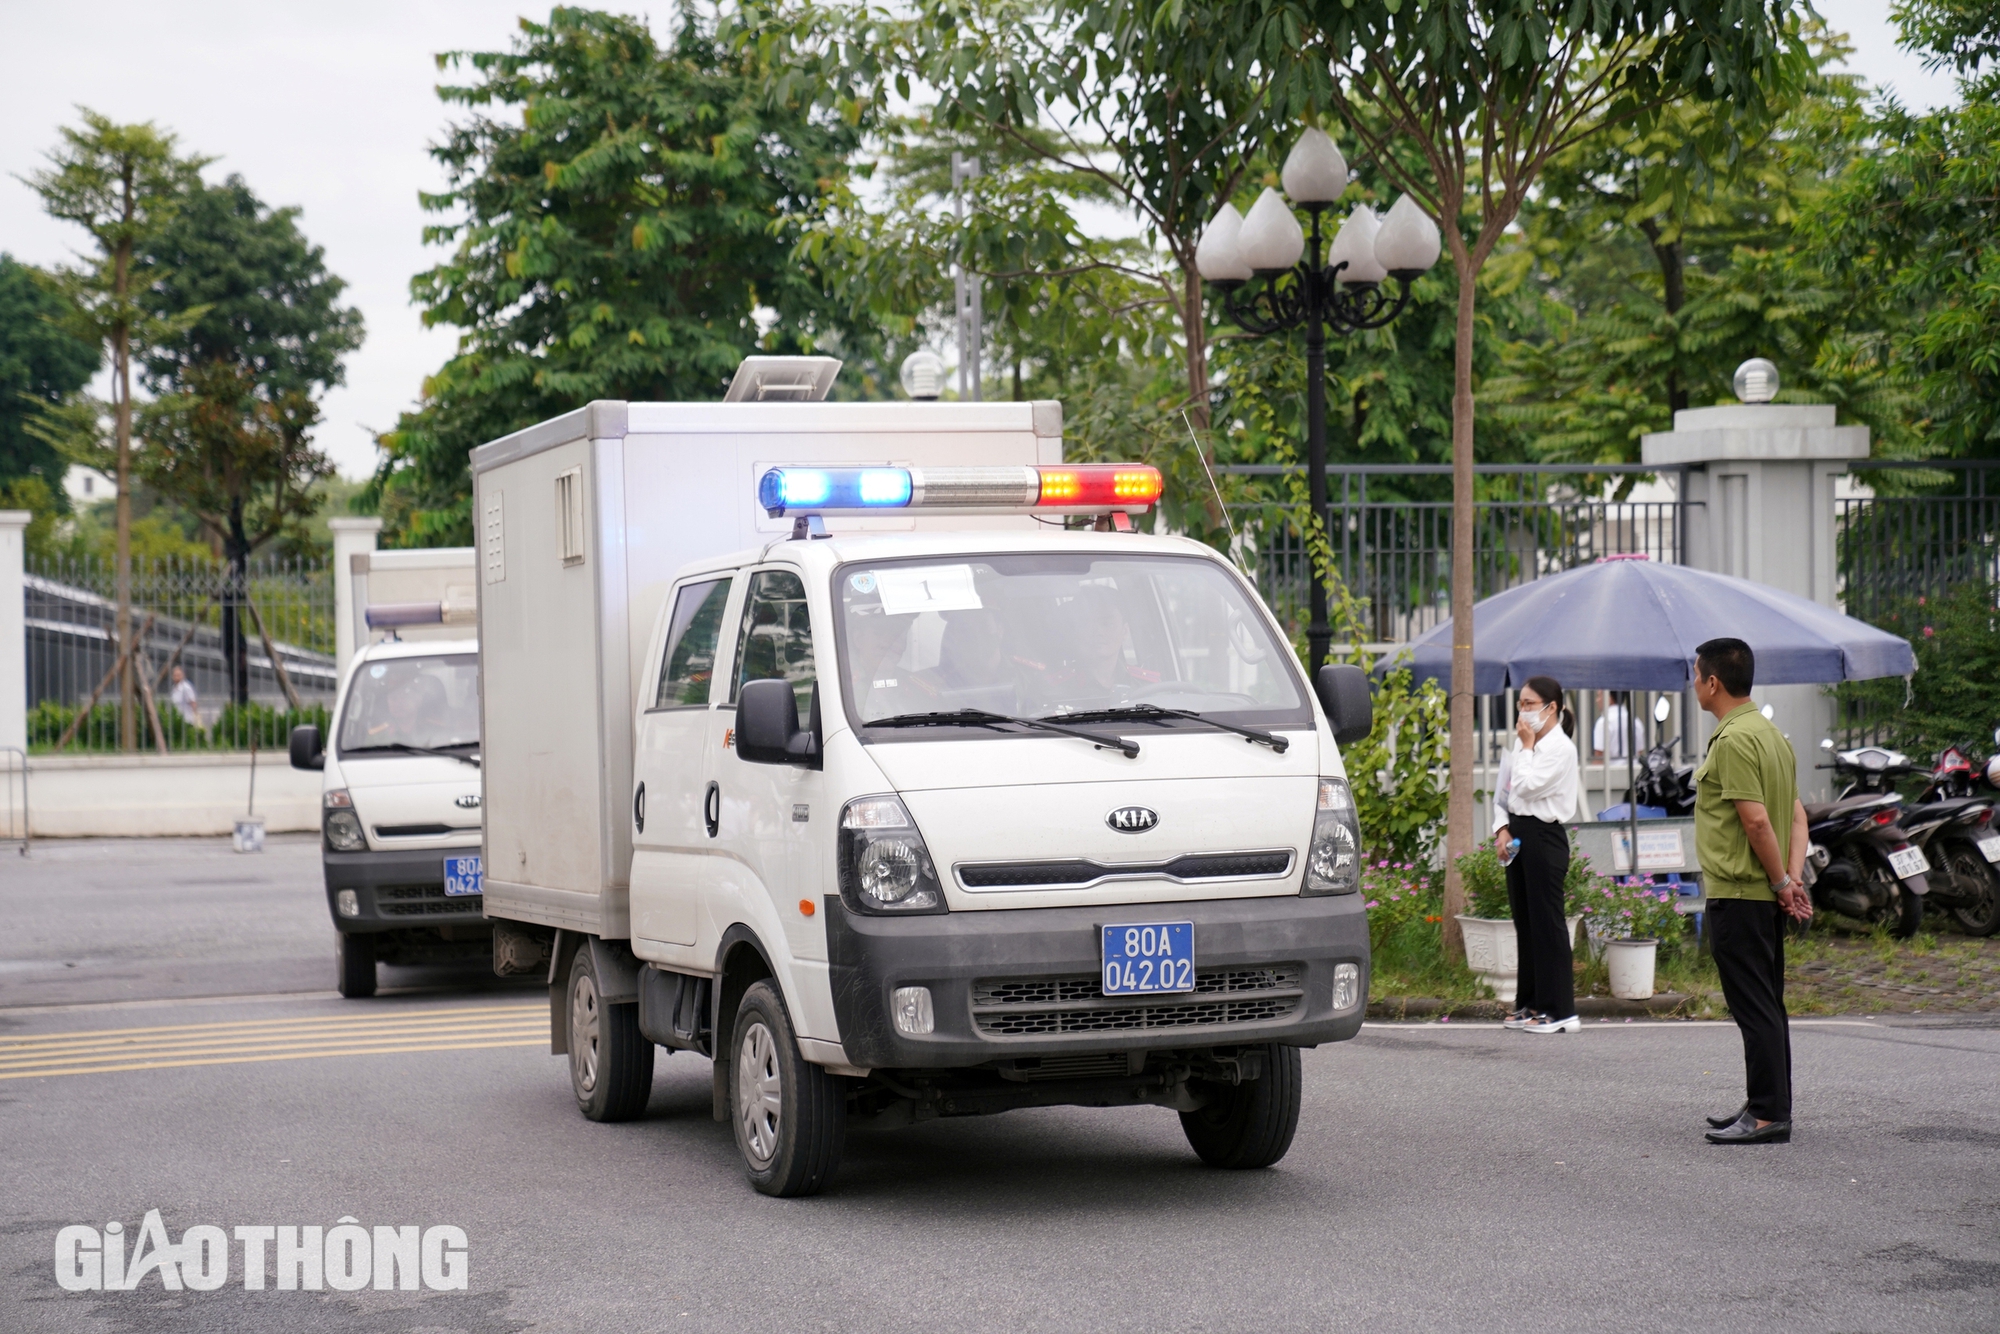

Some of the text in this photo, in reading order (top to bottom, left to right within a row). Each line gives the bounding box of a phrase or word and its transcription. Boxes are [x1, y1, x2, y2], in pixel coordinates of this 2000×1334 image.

[919, 580, 935, 601] 1
[1114, 809, 1153, 828] KIA
[1125, 926, 1172, 958] 80A
[1106, 958, 1191, 991] 042.02
